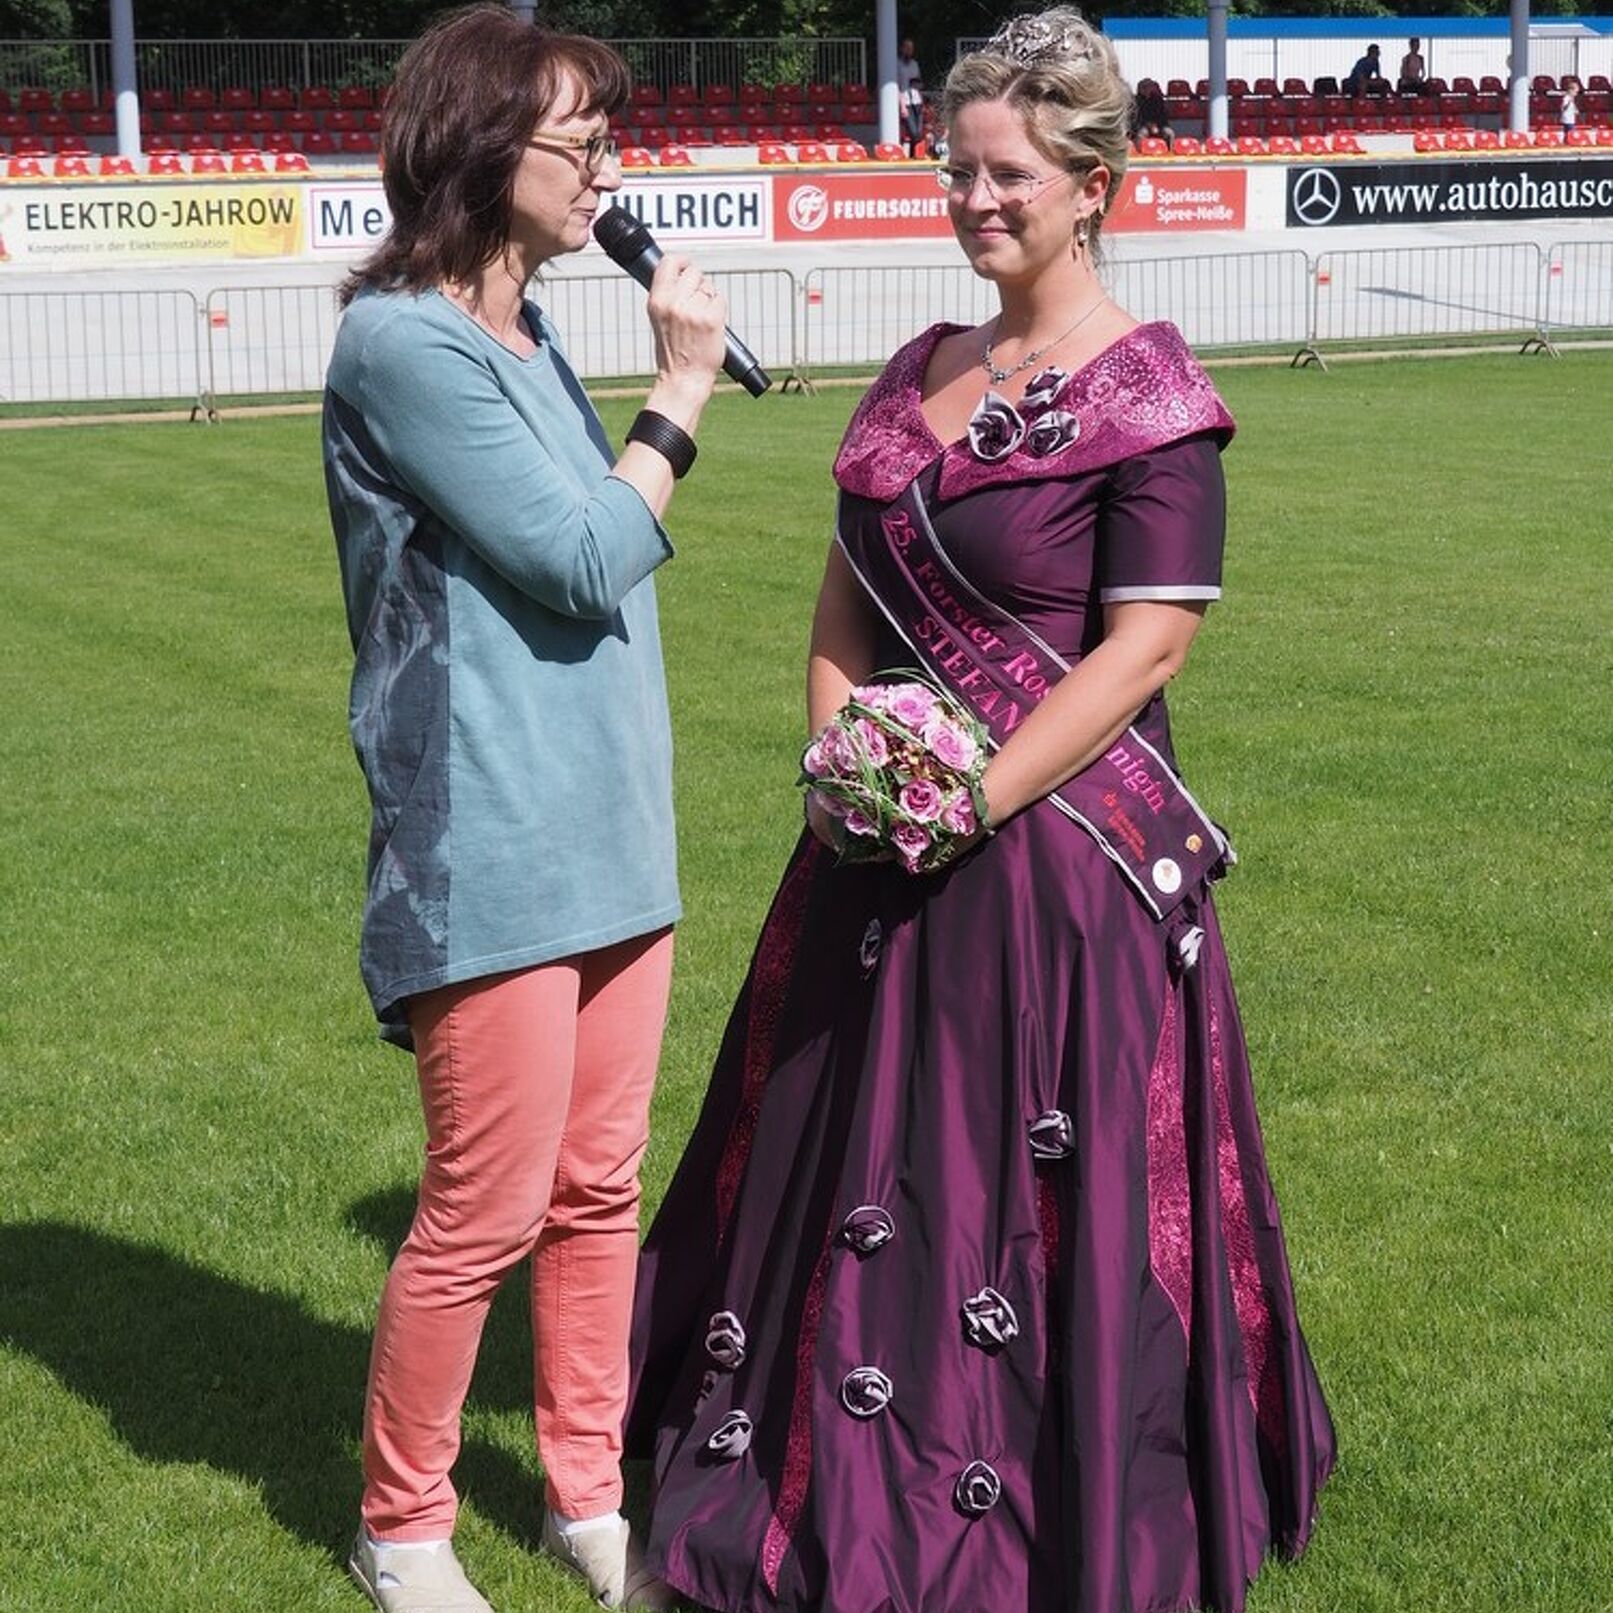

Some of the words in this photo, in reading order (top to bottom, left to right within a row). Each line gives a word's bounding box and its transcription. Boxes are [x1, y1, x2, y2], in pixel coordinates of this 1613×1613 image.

[1157, 187, 1221, 206] Sparkasse
[25, 198, 295, 231] ELEKTRO-JAHROW
[1157, 205, 1234, 224] Spree-Neiße
[885, 511, 917, 555] 25.
[917, 560, 1006, 652] Forster
